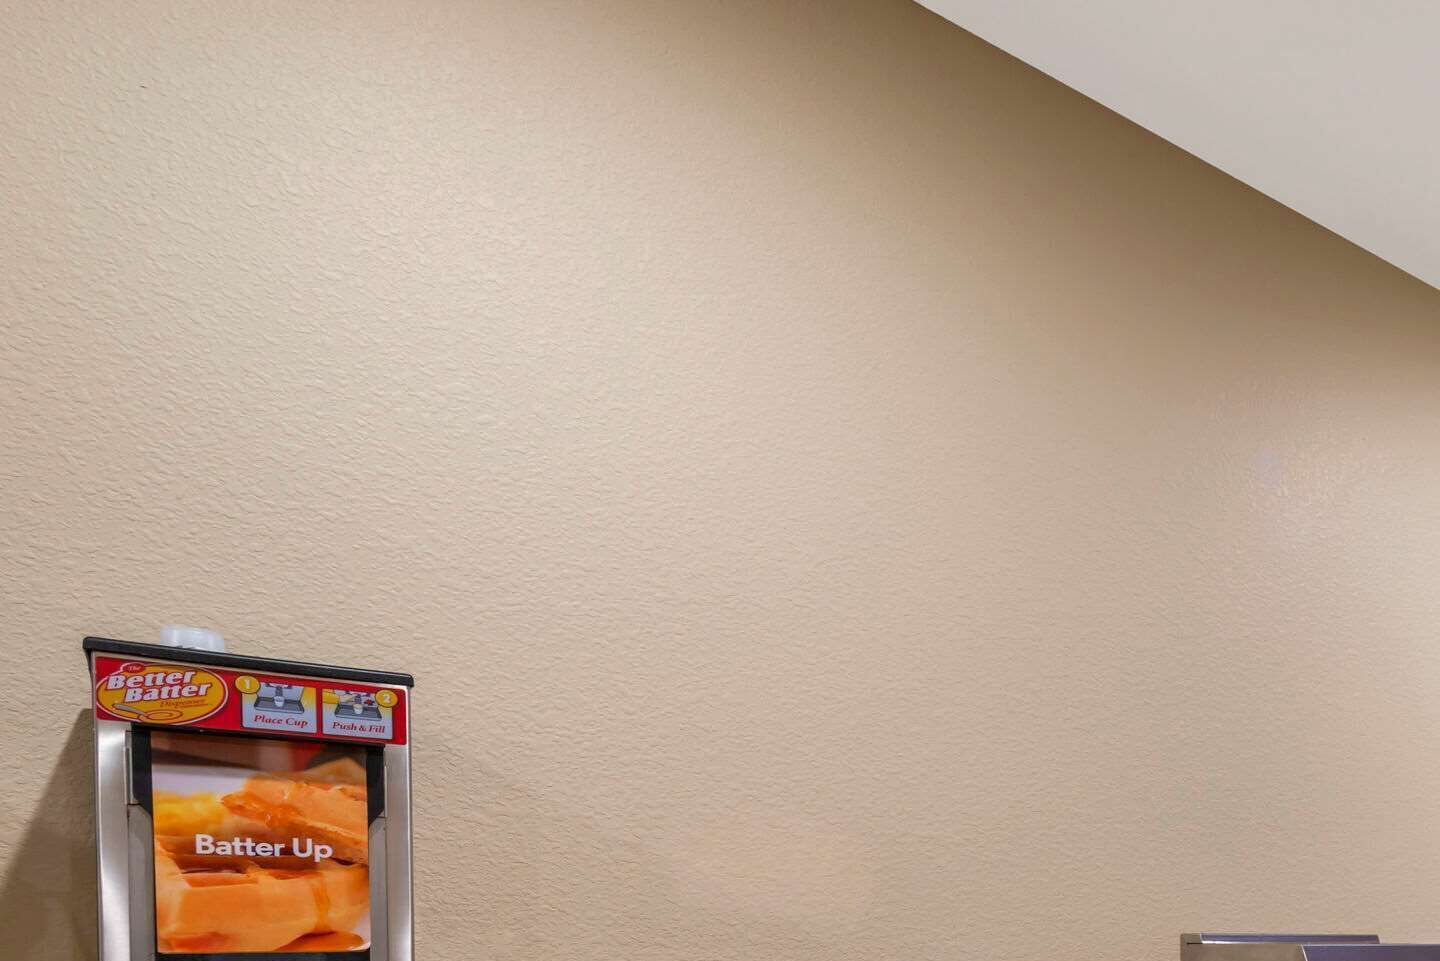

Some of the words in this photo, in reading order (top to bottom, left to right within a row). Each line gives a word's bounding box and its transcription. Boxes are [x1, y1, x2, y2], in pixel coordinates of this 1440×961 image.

[106, 671, 196, 690] Better
[125, 683, 211, 702] Batter
[254, 715, 283, 725] Place
[286, 717, 308, 727] Cup
[332, 721, 356, 731] Push
[368, 725, 386, 734] Fill
[194, 834, 285, 857] Batter
[292, 838, 333, 862] Up
